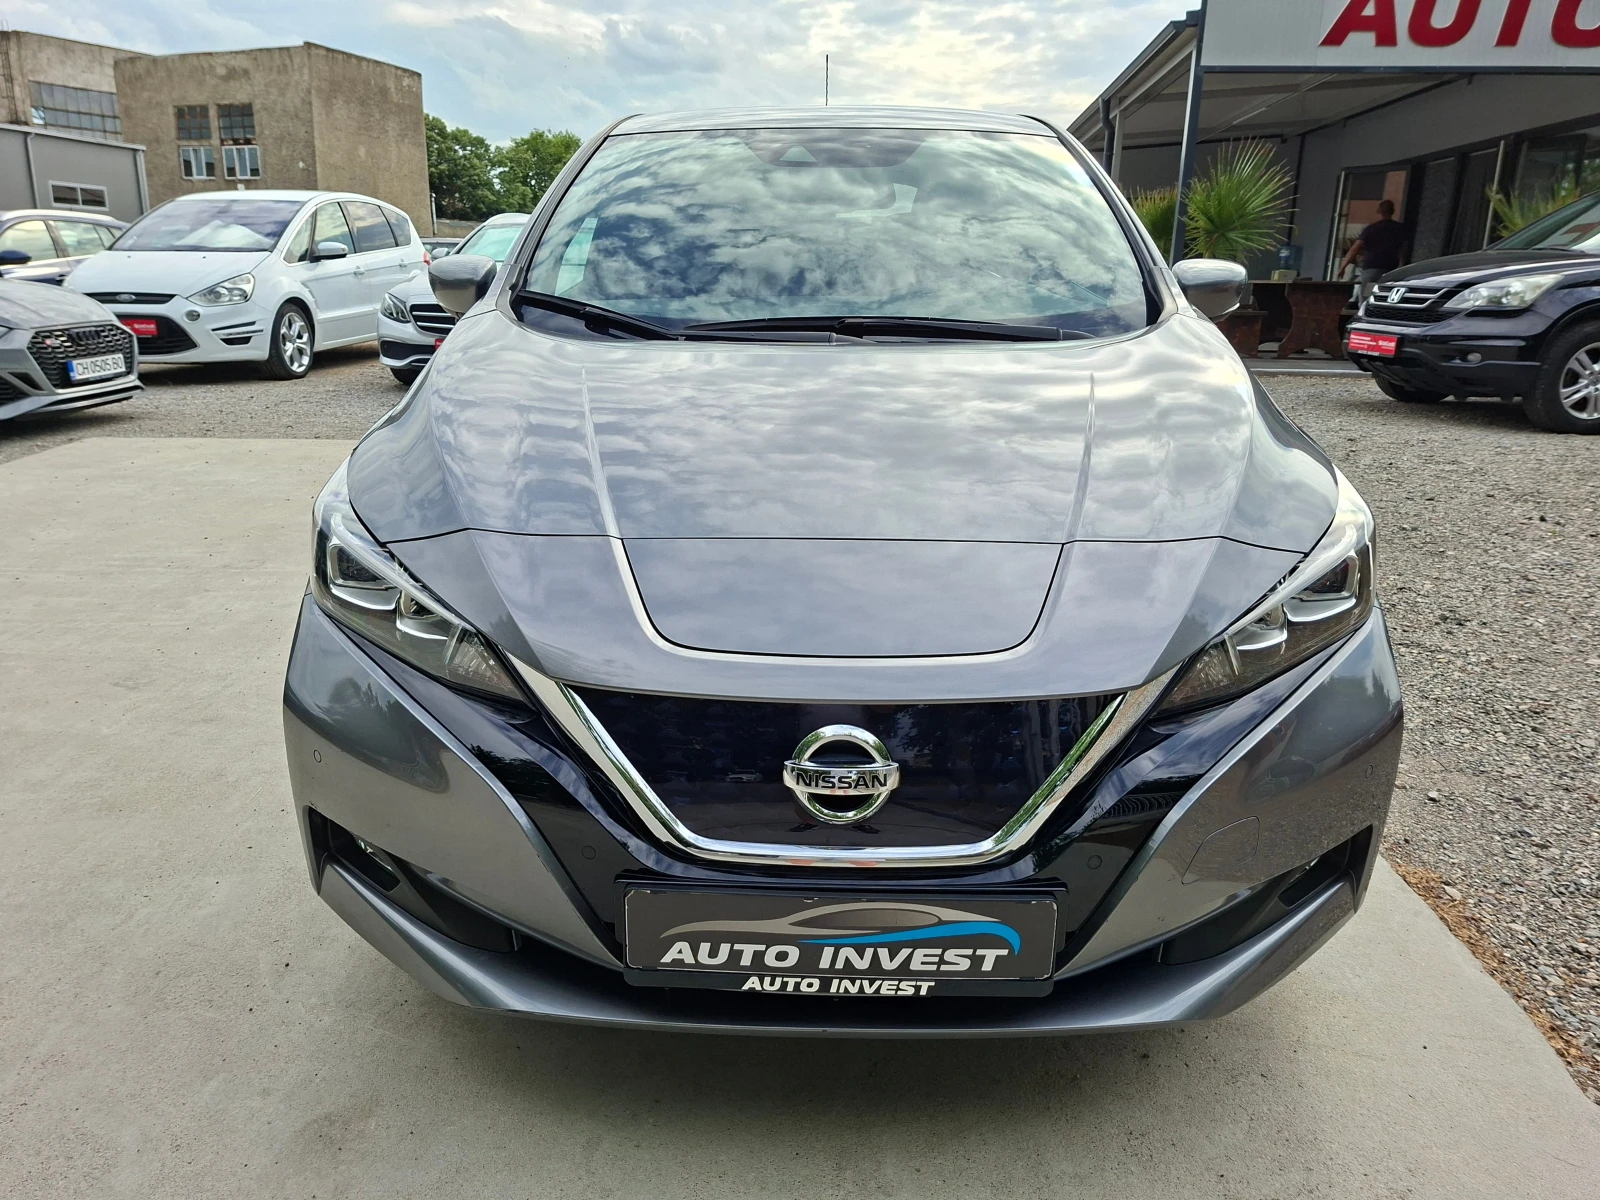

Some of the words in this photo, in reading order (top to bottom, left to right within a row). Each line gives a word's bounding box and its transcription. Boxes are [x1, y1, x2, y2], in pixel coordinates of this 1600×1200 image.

[796, 770, 888, 790] NISSAN
[660, 941, 800, 968] AUTO
[818, 946, 1009, 972] INVEST
[741, 976, 821, 993] AUTO
[830, 978, 936, 996] INVEST
